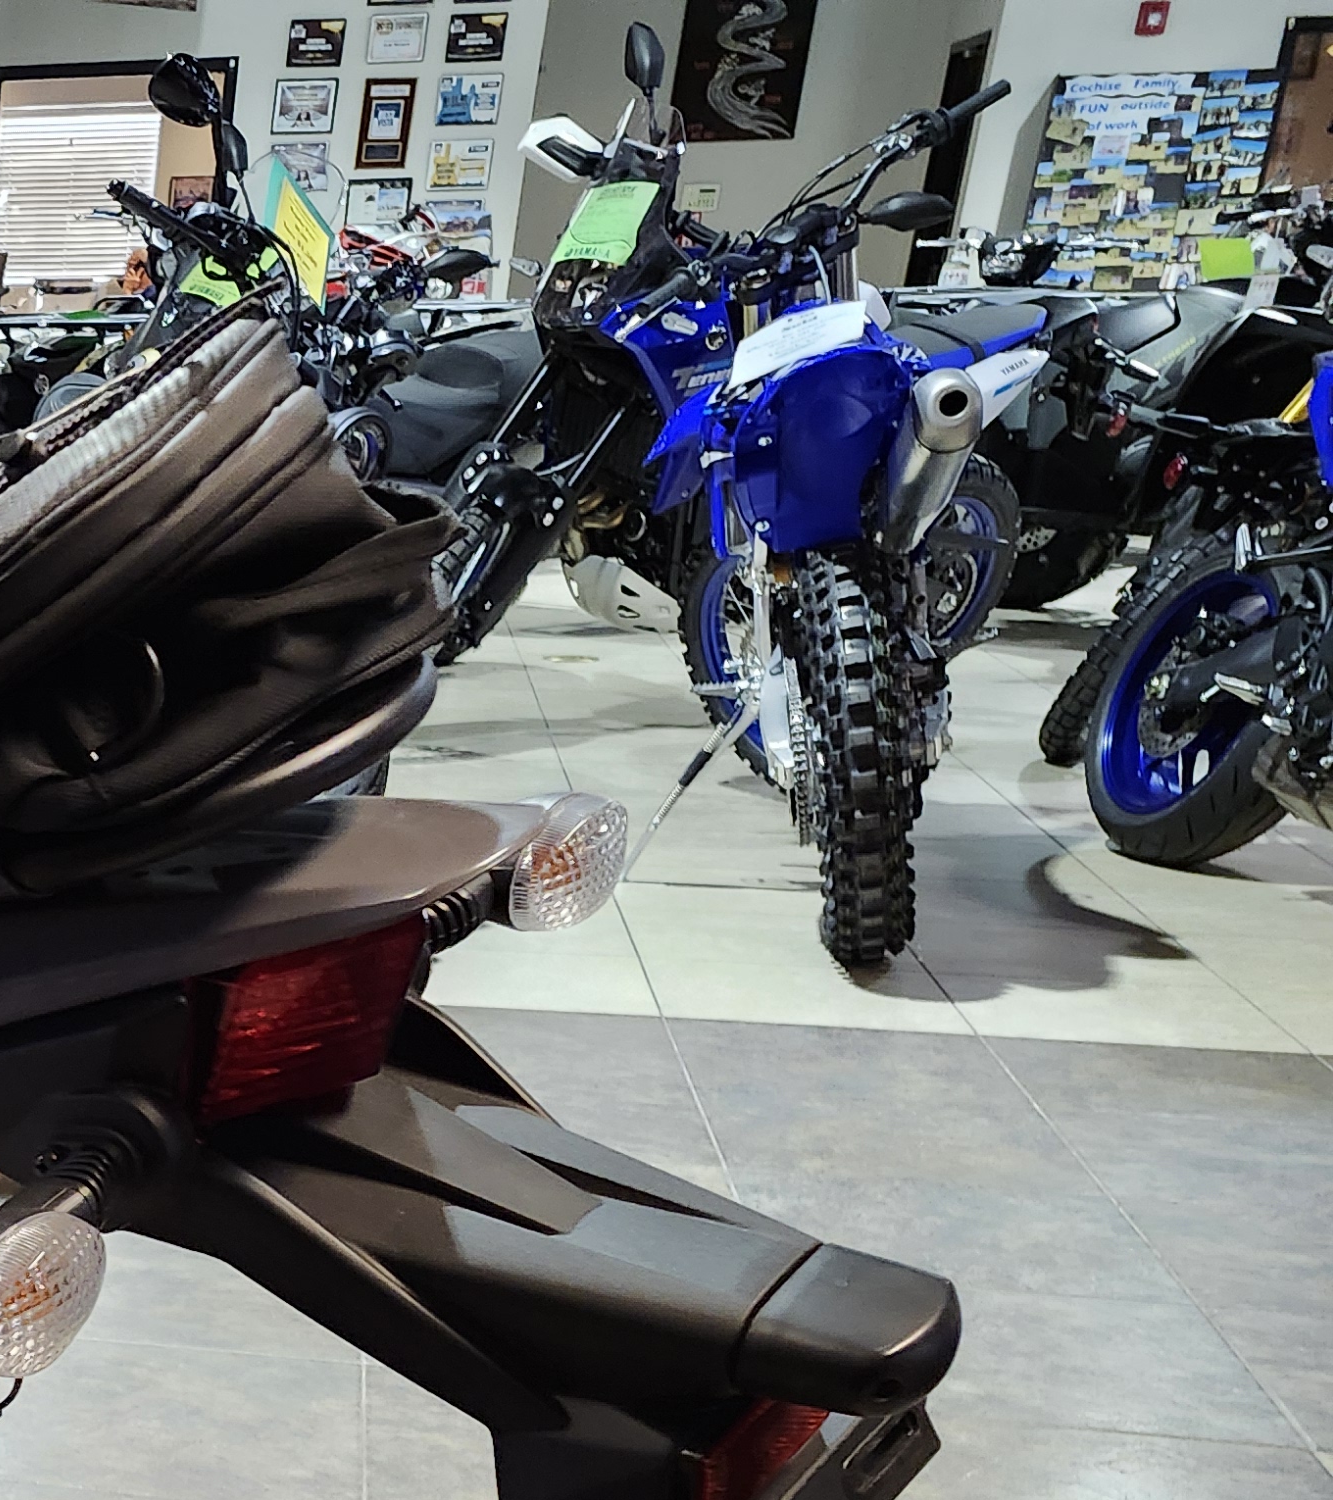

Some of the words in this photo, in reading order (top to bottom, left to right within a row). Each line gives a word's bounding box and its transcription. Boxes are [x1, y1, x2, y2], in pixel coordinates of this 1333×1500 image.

[1070, 82, 1122, 93] Cochise
[1080, 102, 1109, 114] FUN
[1120, 100, 1171, 111] outside
[1088, 120, 1102, 131] of
[1104, 120, 1138, 130] work
[1000, 357, 1030, 377] YAMAHA
